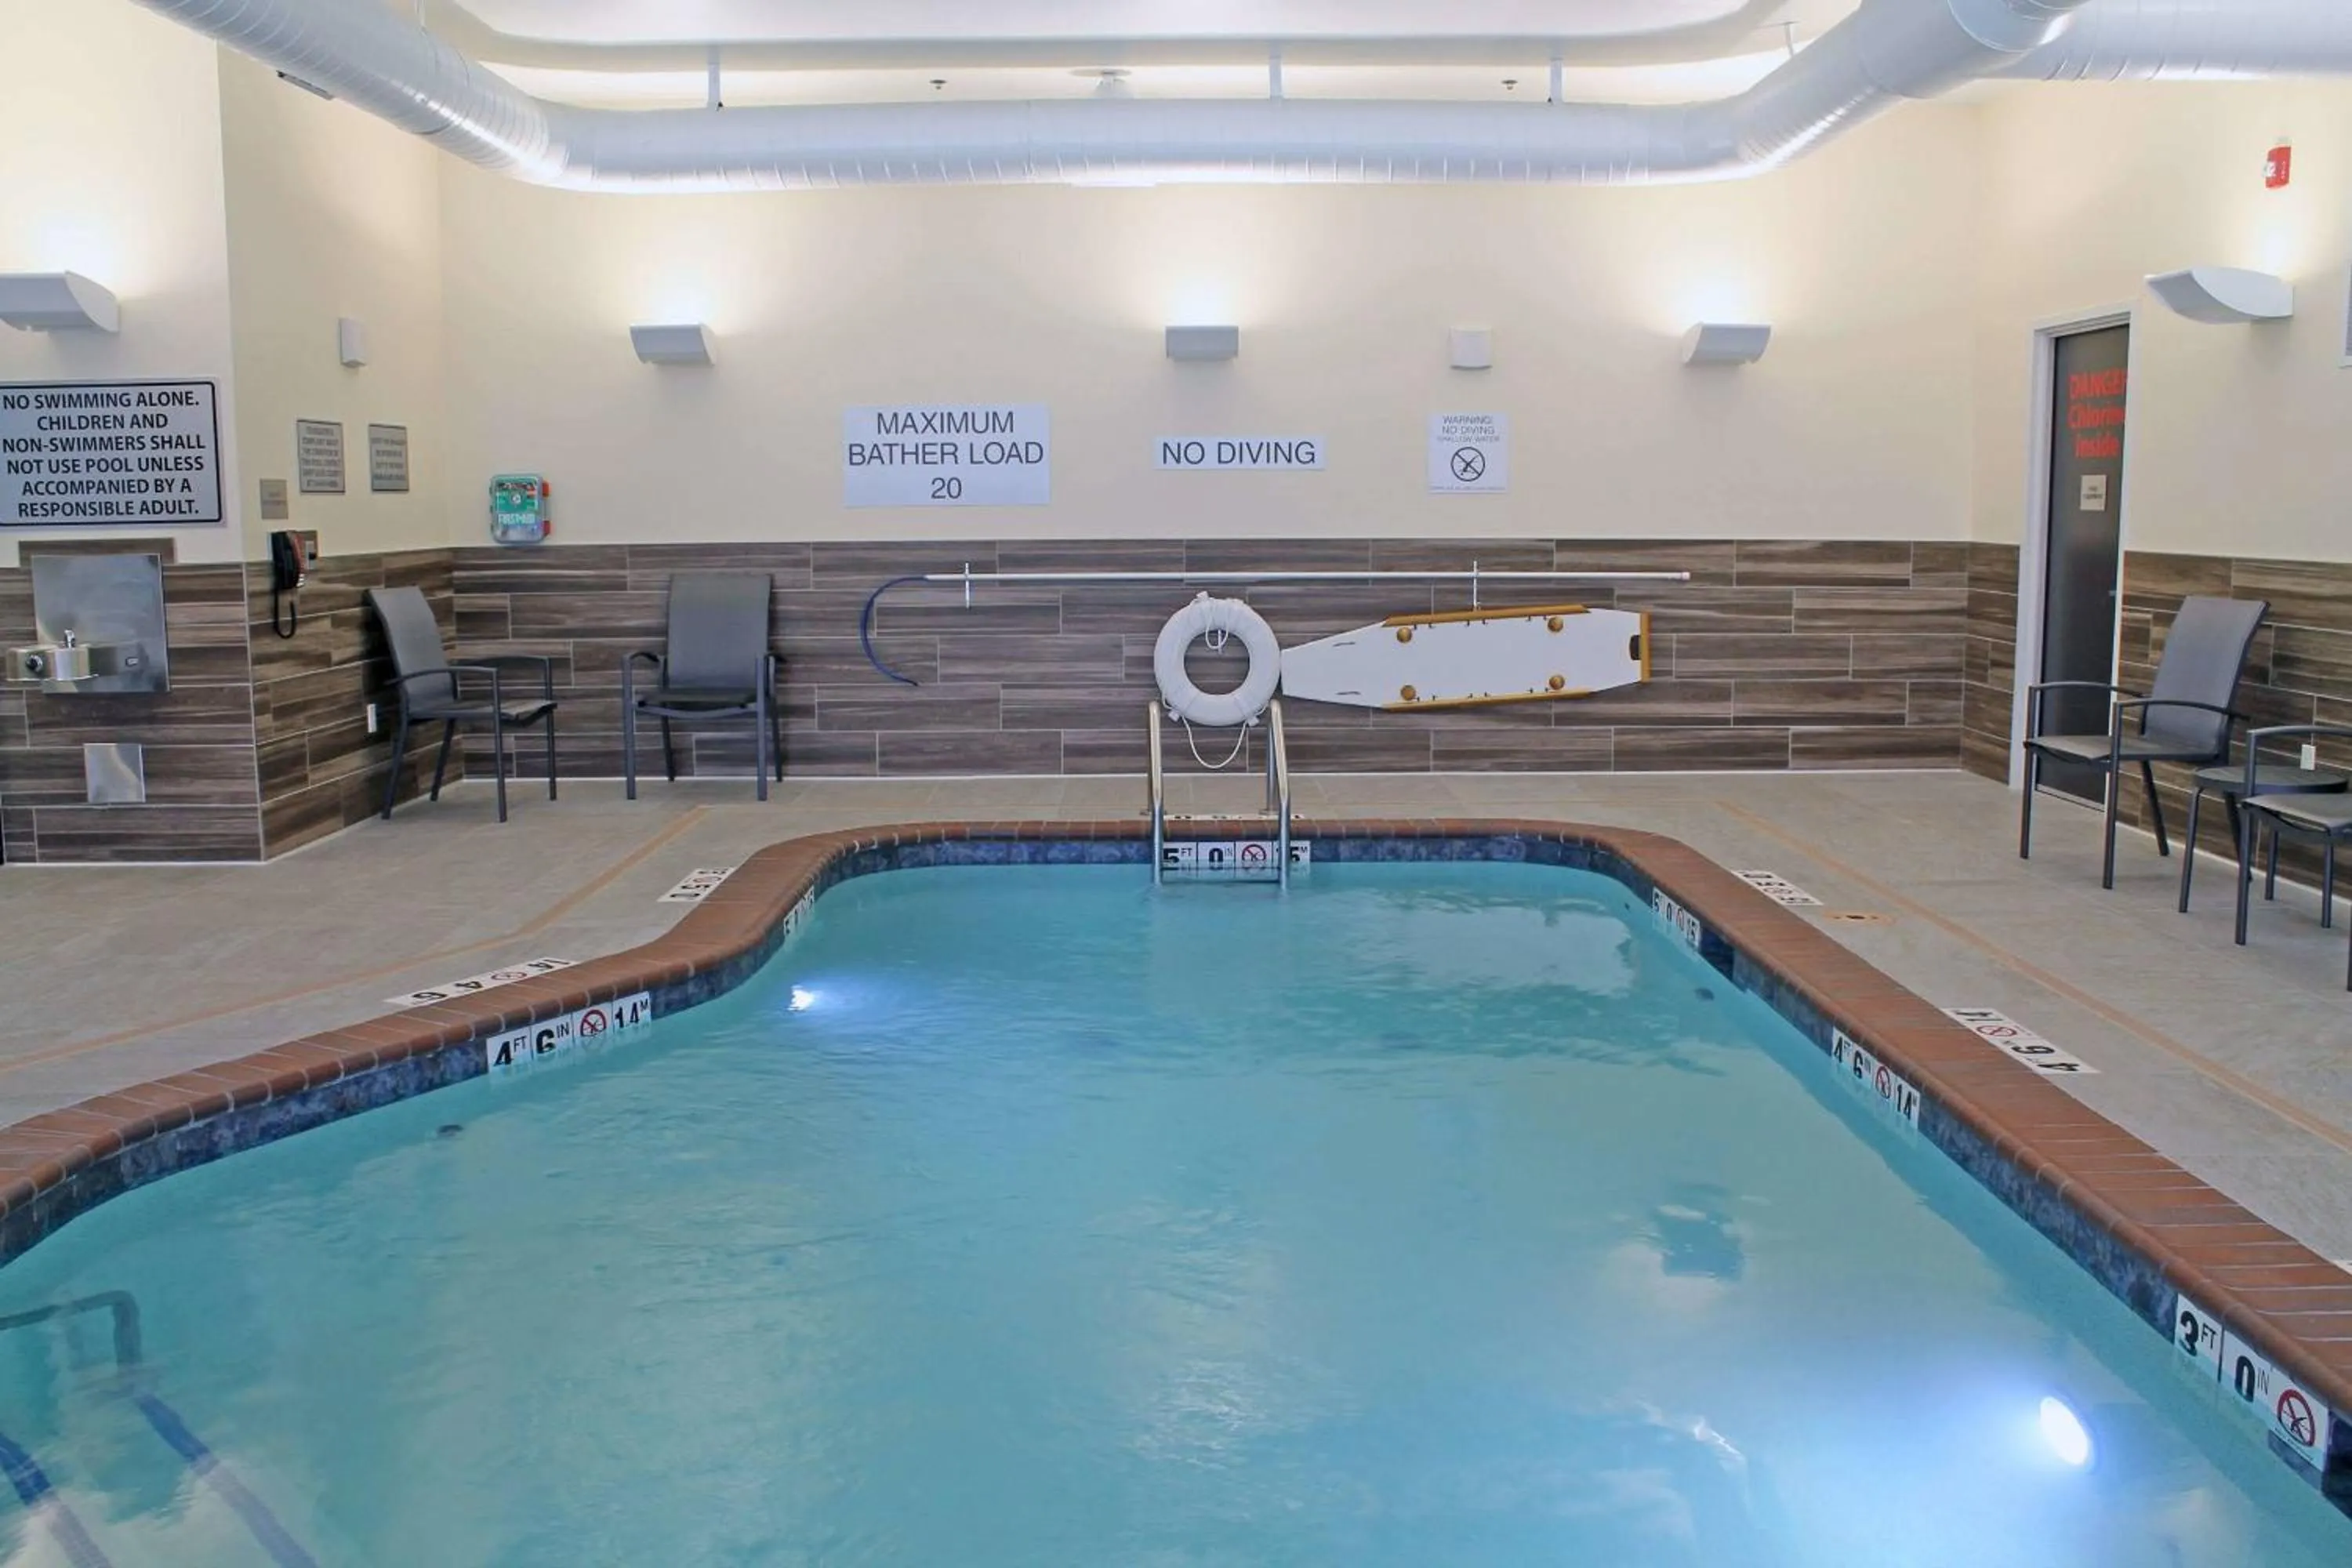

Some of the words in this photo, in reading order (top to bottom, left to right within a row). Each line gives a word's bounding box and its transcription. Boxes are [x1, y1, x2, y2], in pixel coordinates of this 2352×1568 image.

[3, 394, 30, 409] NO
[34, 393, 132, 408] SWIMMING
[136, 391, 200, 407] ALONE.
[37, 415, 125, 430] CHILDREN
[130, 413, 169, 429] AND
[877, 411, 1014, 434] MAXIMUM
[1442, 426, 1457, 434] NO
[1461, 426, 1495, 434] DIVING
[2, 435, 147, 453] NON-SWIMMERS
[151, 434, 206, 450] SHALL
[848, 442, 959, 466] BATHER
[969, 441, 1044, 465] LOAD
[1162, 441, 1205, 466] NO
[1217, 441, 1316, 466] DIVING
[7, 459, 44, 474] NOT
[48, 459, 82, 474] USE
[85, 457, 133, 473] POOL
[137, 456, 205, 471] UNLESS
[22, 478, 150, 495] ACCOMPANIED
[154, 477, 175, 493] BY
[180, 477, 192, 492] A
[931, 477, 963, 499] 20
[18, 500, 135, 517] RESPONSIBLE
[139, 499, 200, 515] ADULT.
[535, 1029, 557, 1054] 6
[2180, 1310, 2199, 1357] 3
[2234, 1356, 2256, 1403] 0
